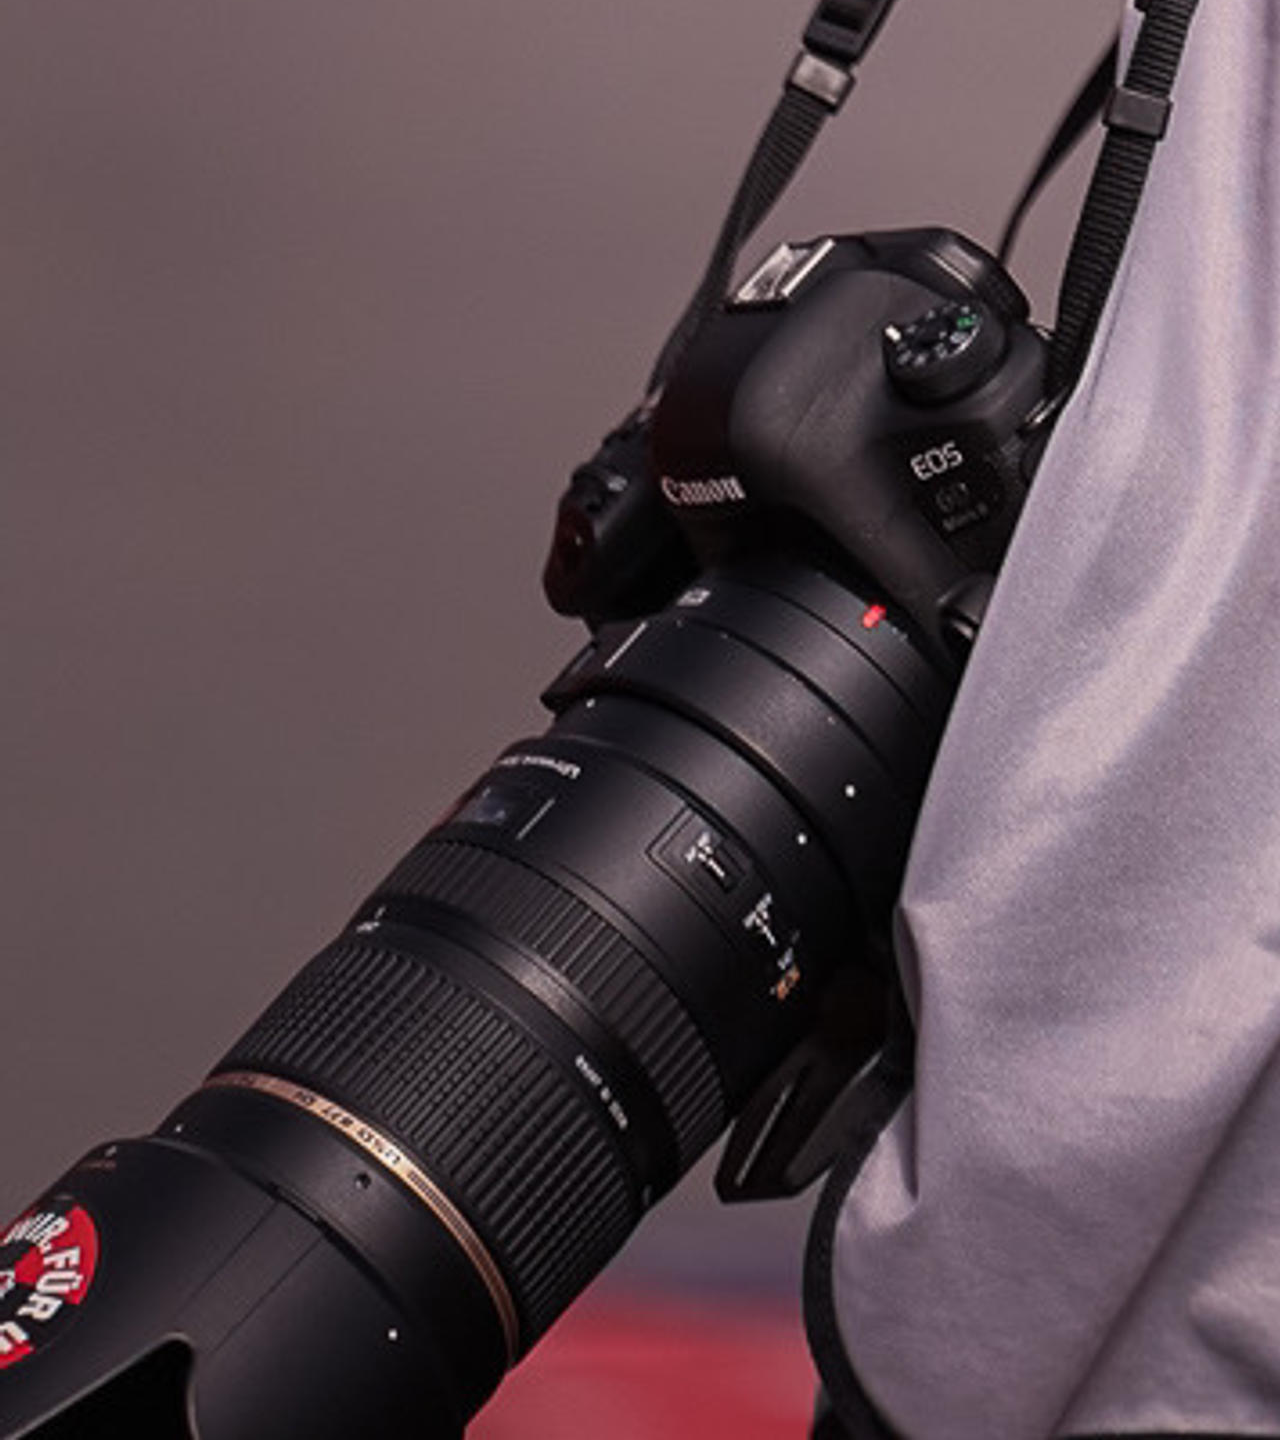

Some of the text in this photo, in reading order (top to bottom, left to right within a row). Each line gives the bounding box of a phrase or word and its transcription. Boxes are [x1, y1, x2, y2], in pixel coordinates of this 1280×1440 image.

[909, 439, 964, 481] EOS
[661, 475, 747, 507] Canon
[16, 1246, 84, 1321] FÜR
